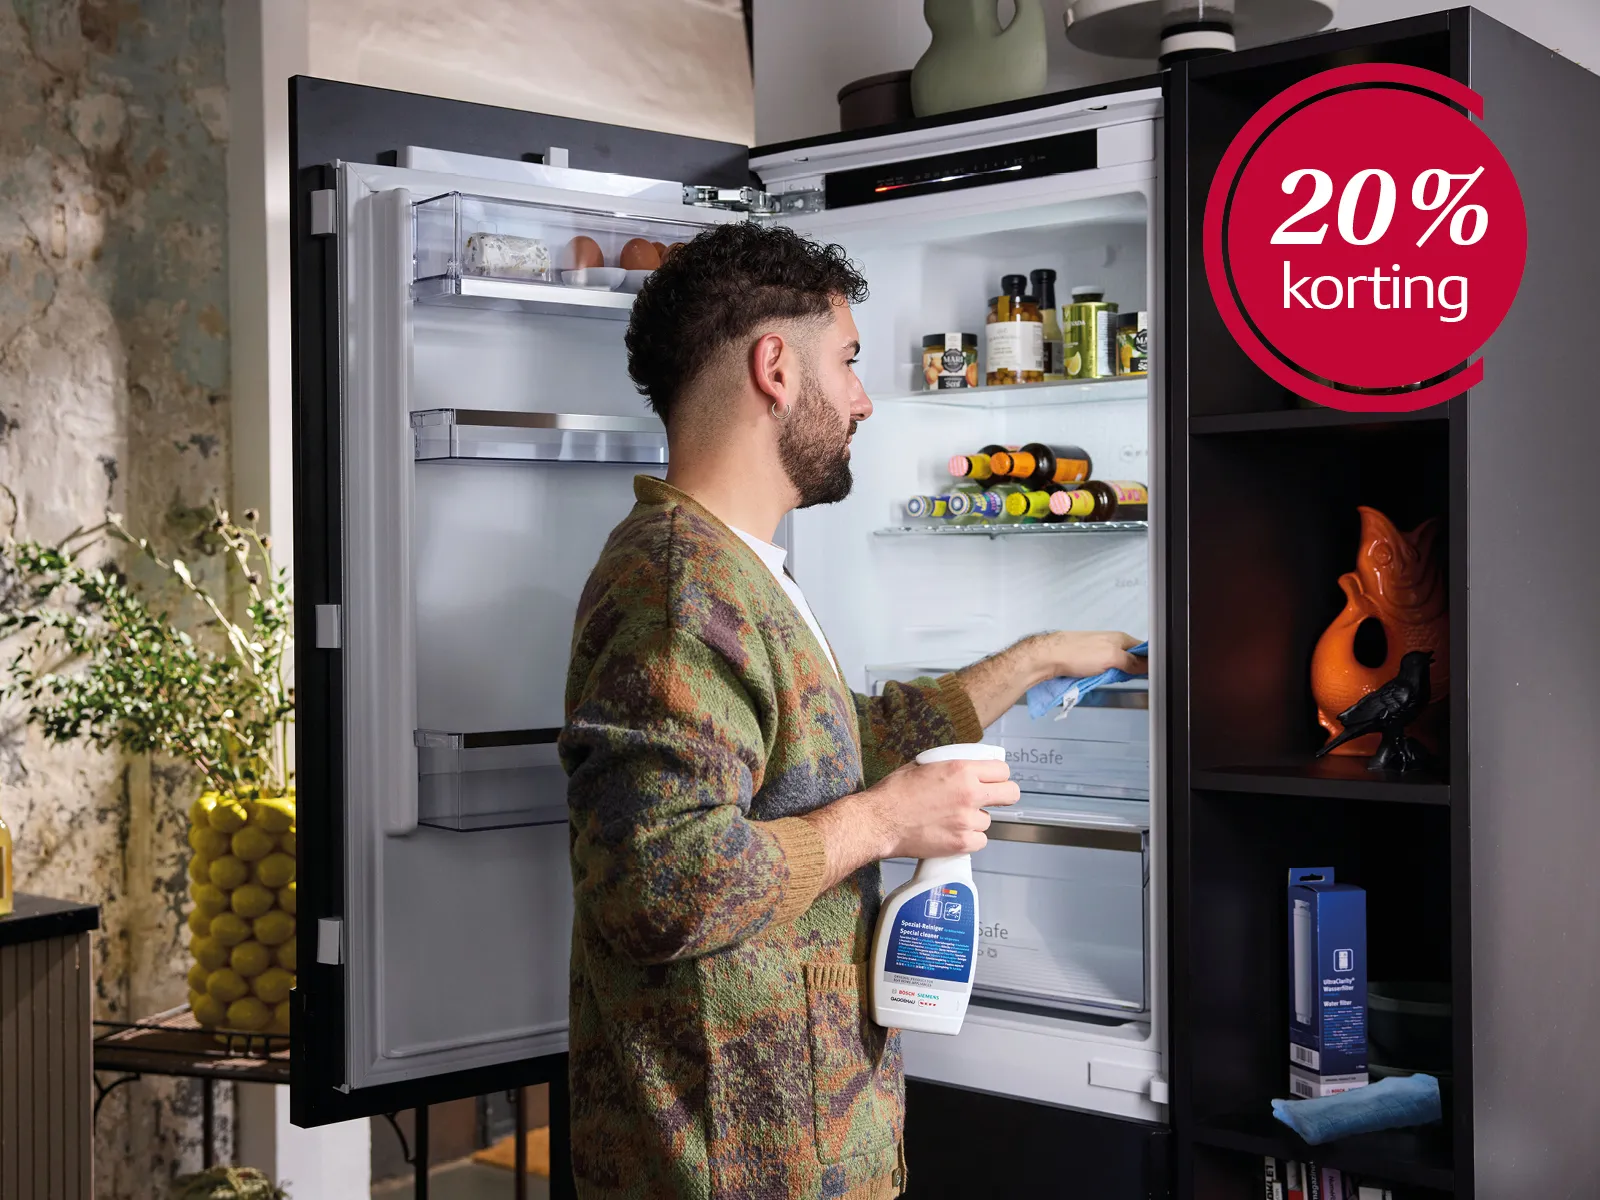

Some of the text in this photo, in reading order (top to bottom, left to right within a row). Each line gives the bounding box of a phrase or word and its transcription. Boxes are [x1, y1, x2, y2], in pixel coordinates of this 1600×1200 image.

[901, 920, 944, 932] Spezial-Reiniger
[900, 928, 919, 936] Special
[920, 931, 940, 939] cleaner
